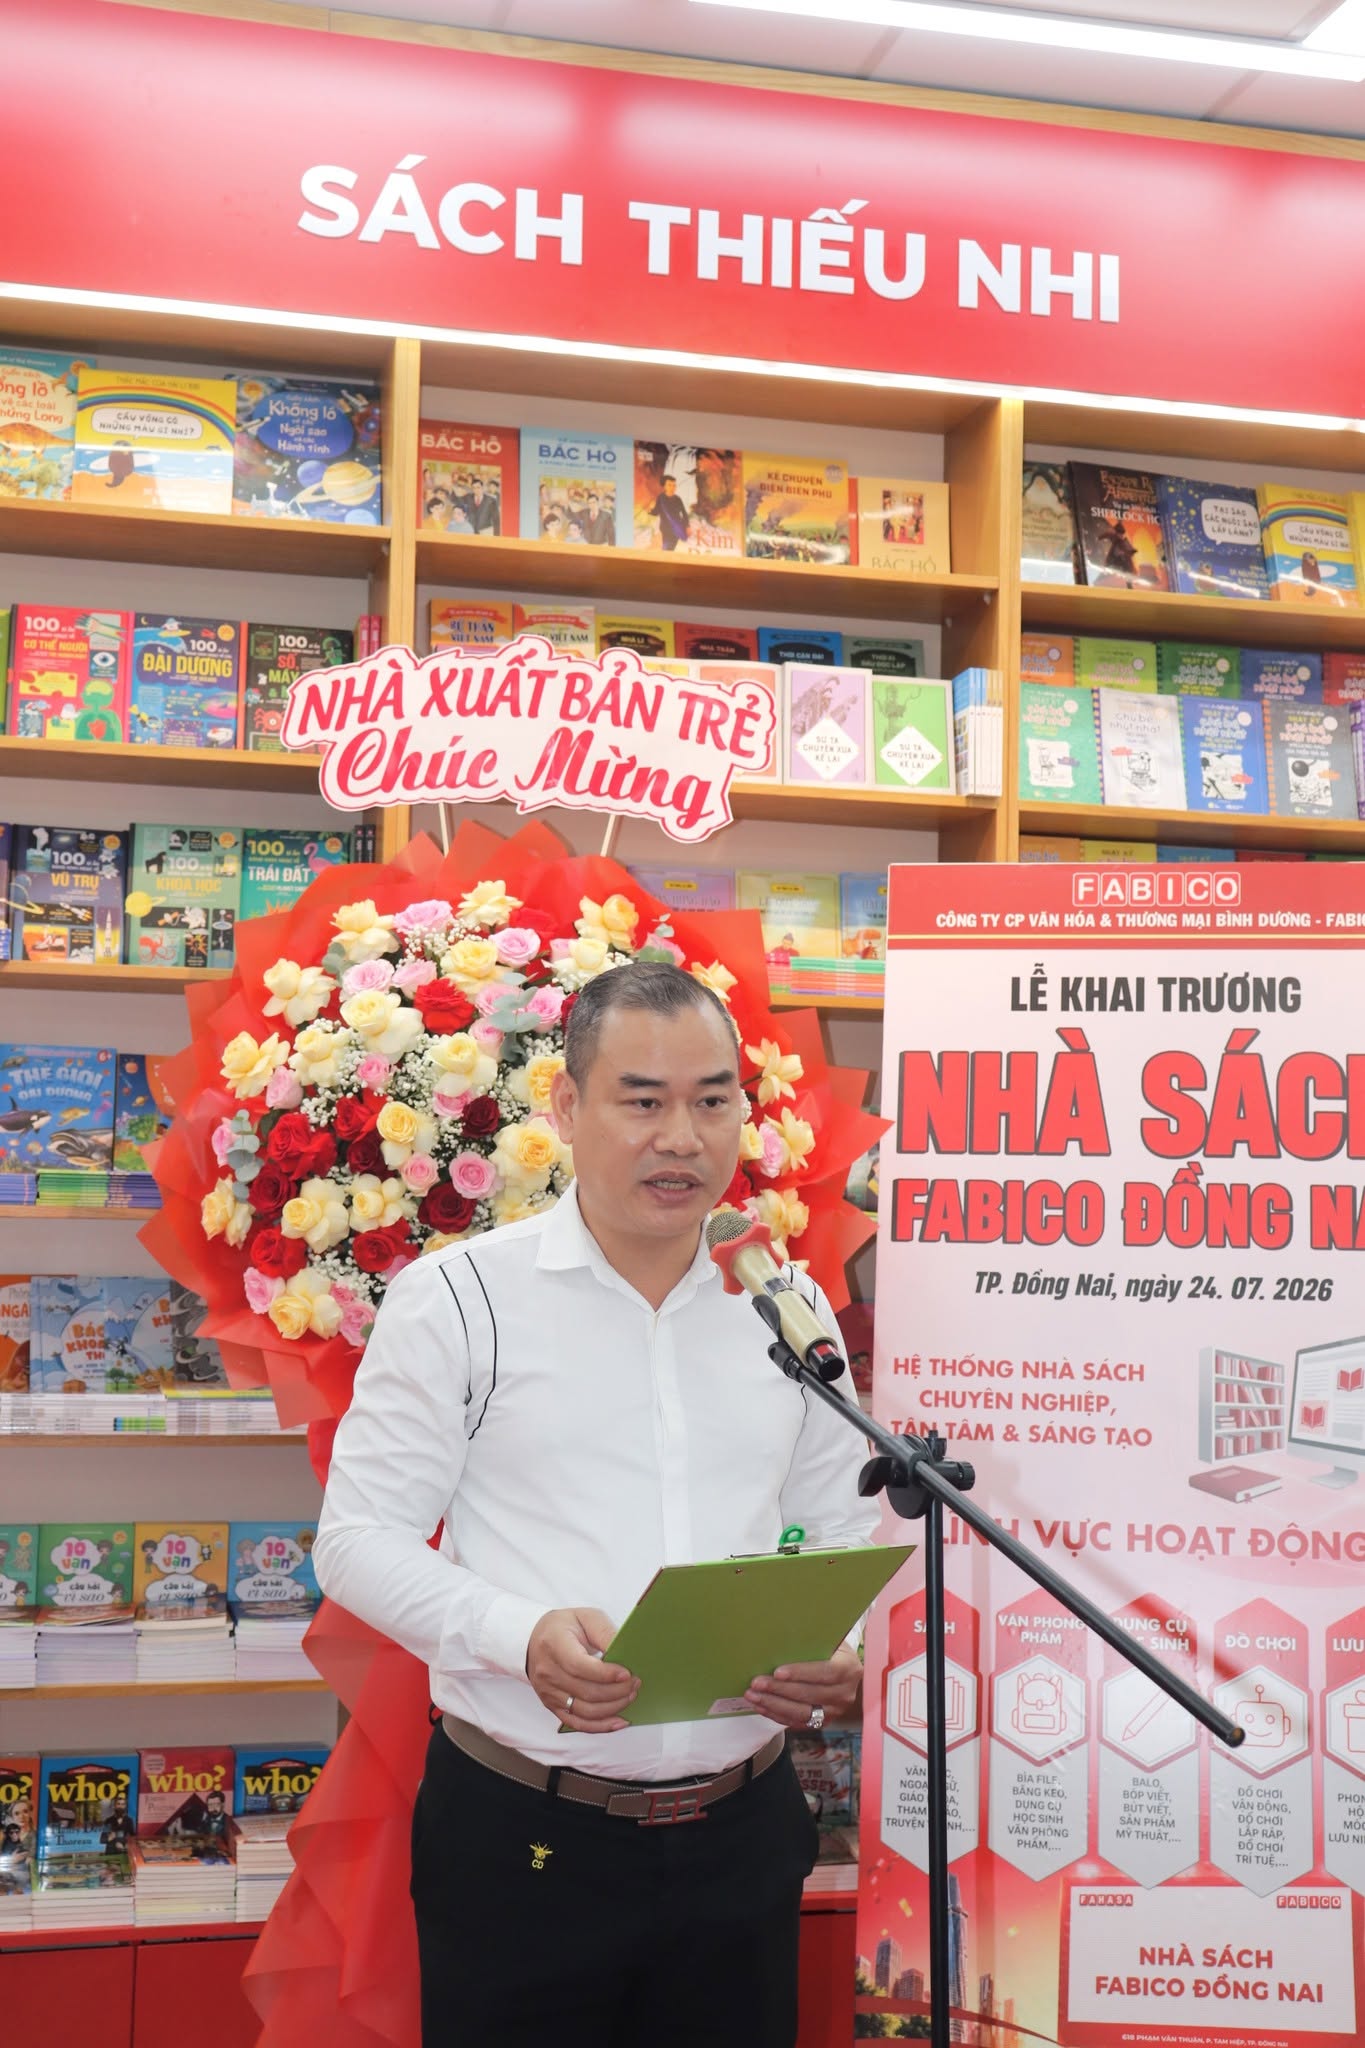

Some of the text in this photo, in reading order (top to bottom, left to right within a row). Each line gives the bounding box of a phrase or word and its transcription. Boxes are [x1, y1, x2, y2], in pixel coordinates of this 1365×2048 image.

[297, 153, 1120, 323] SÁCH THIẾU NHI
[421, 434, 465, 451] BÁC
[539, 443, 580, 461] BÁC
[696, 529, 734, 550] Kim
[24, 616, 60, 632] 100
[190, 639, 218, 653] 100
[278, 634, 308, 649] 100
[143, 652, 233, 678] ĐẠI DƯƠNG
[297, 648, 762, 759] NHÀ XUẤT BẢN TRẺ
[336, 725, 716, 830] Chúc Mừng
[247, 839, 285, 856] 100
[53, 850, 86, 866] 100
[168, 857, 200, 870] 100
[248, 862, 311, 883] TRÁI ĐẤT
[1077, 878, 1239, 902] FABICO
[936, 910, 977, 928] CÔNG
[982, 912, 1000, 927] TY
[1004, 912, 1026, 927] CP
[1029, 911, 1059, 927] VĂN
[1063, 909, 1095, 928] HÓA
[1100, 912, 1112, 928] &
[1115, 911, 1178, 929] THƯƠNG
[1182, 912, 1212, 931] MẠI
[1216, 908, 1253, 928] BÌNH
[1258, 911, 1311, 928] DƯƠNG
[1010, 962, 1302, 1014] LỄ KHAI TRƯƠNG
[896, 1027, 1111, 1157] NHÀ
[891, 1162, 1294, 1251] FABICO ĐỒNG
[974, 1268, 1334, 1303] TP. Đồng Nai, ngày 24. 07. 2026
[893, 1353, 1145, 1382] HỆ THỐNG NHÀ SÁCH
[919, 1387, 1118, 1417] CHUYÊN NGHIỆP,
[945, 1418, 1152, 1450] TÂM & SÁNG TẠO
[65, 1541, 87, 1557] 10
[165, 1540, 187, 1555] 10
[265, 1541, 286, 1557] 10
[1033, 1518, 1365, 1567] VỰC HOẠT ĐỘNG
[1165, 1618, 1187, 1636] CỤ
[1150, 1636, 1190, 1652] SINH
[1256, 1635, 1297, 1652] CHƠI
[48, 1772, 131, 1804] who?
[148, 1765, 226, 1793] who?
[900, 1790, 925, 1803] GIÁO
[1256, 1787, 1283, 1800] CHƠI
[897, 1805, 927, 1816] THAM
[1038, 1814, 1063, 1825] SINH
[885, 1818, 925, 1830] TRUYỆN
[1256, 1813, 1283, 1827] CHƠI
[1328, 1832, 1350, 1843] LƯU
[1256, 1841, 1284, 1854] CHƠI
[1079, 1895, 1341, 1908] FAHASA FABICO
[1138, 1943, 1273, 1969] NHÀ SÁCH
[1094, 1973, 1323, 2003] FABICO ĐỒNG NAI
